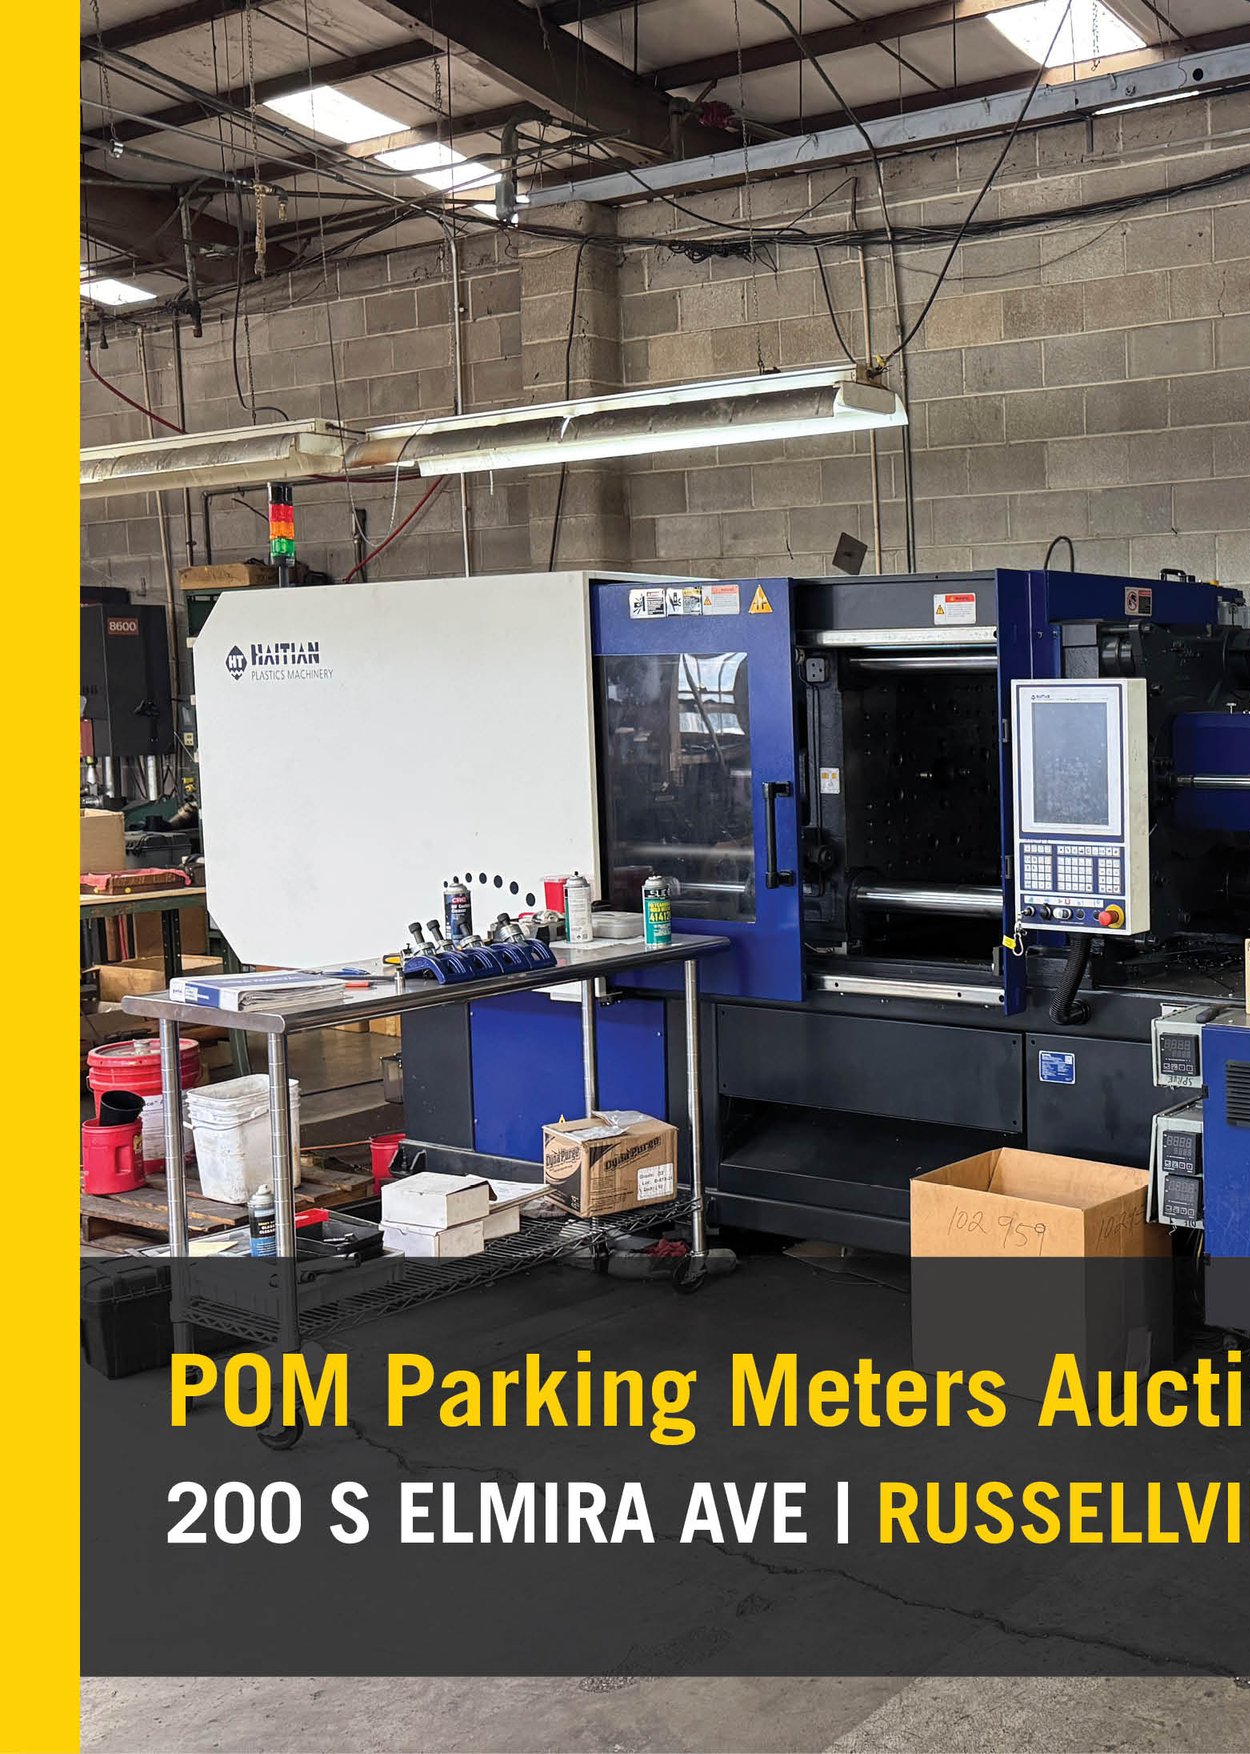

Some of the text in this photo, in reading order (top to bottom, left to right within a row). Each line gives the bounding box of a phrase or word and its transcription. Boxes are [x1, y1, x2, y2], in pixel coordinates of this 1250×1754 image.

[108, 620, 137, 632] 8600
[250, 641, 320, 666] HAITIAN
[251, 668, 334, 681] PLASTICS MACHINERY
[947, 1207, 988, 1235] 102
